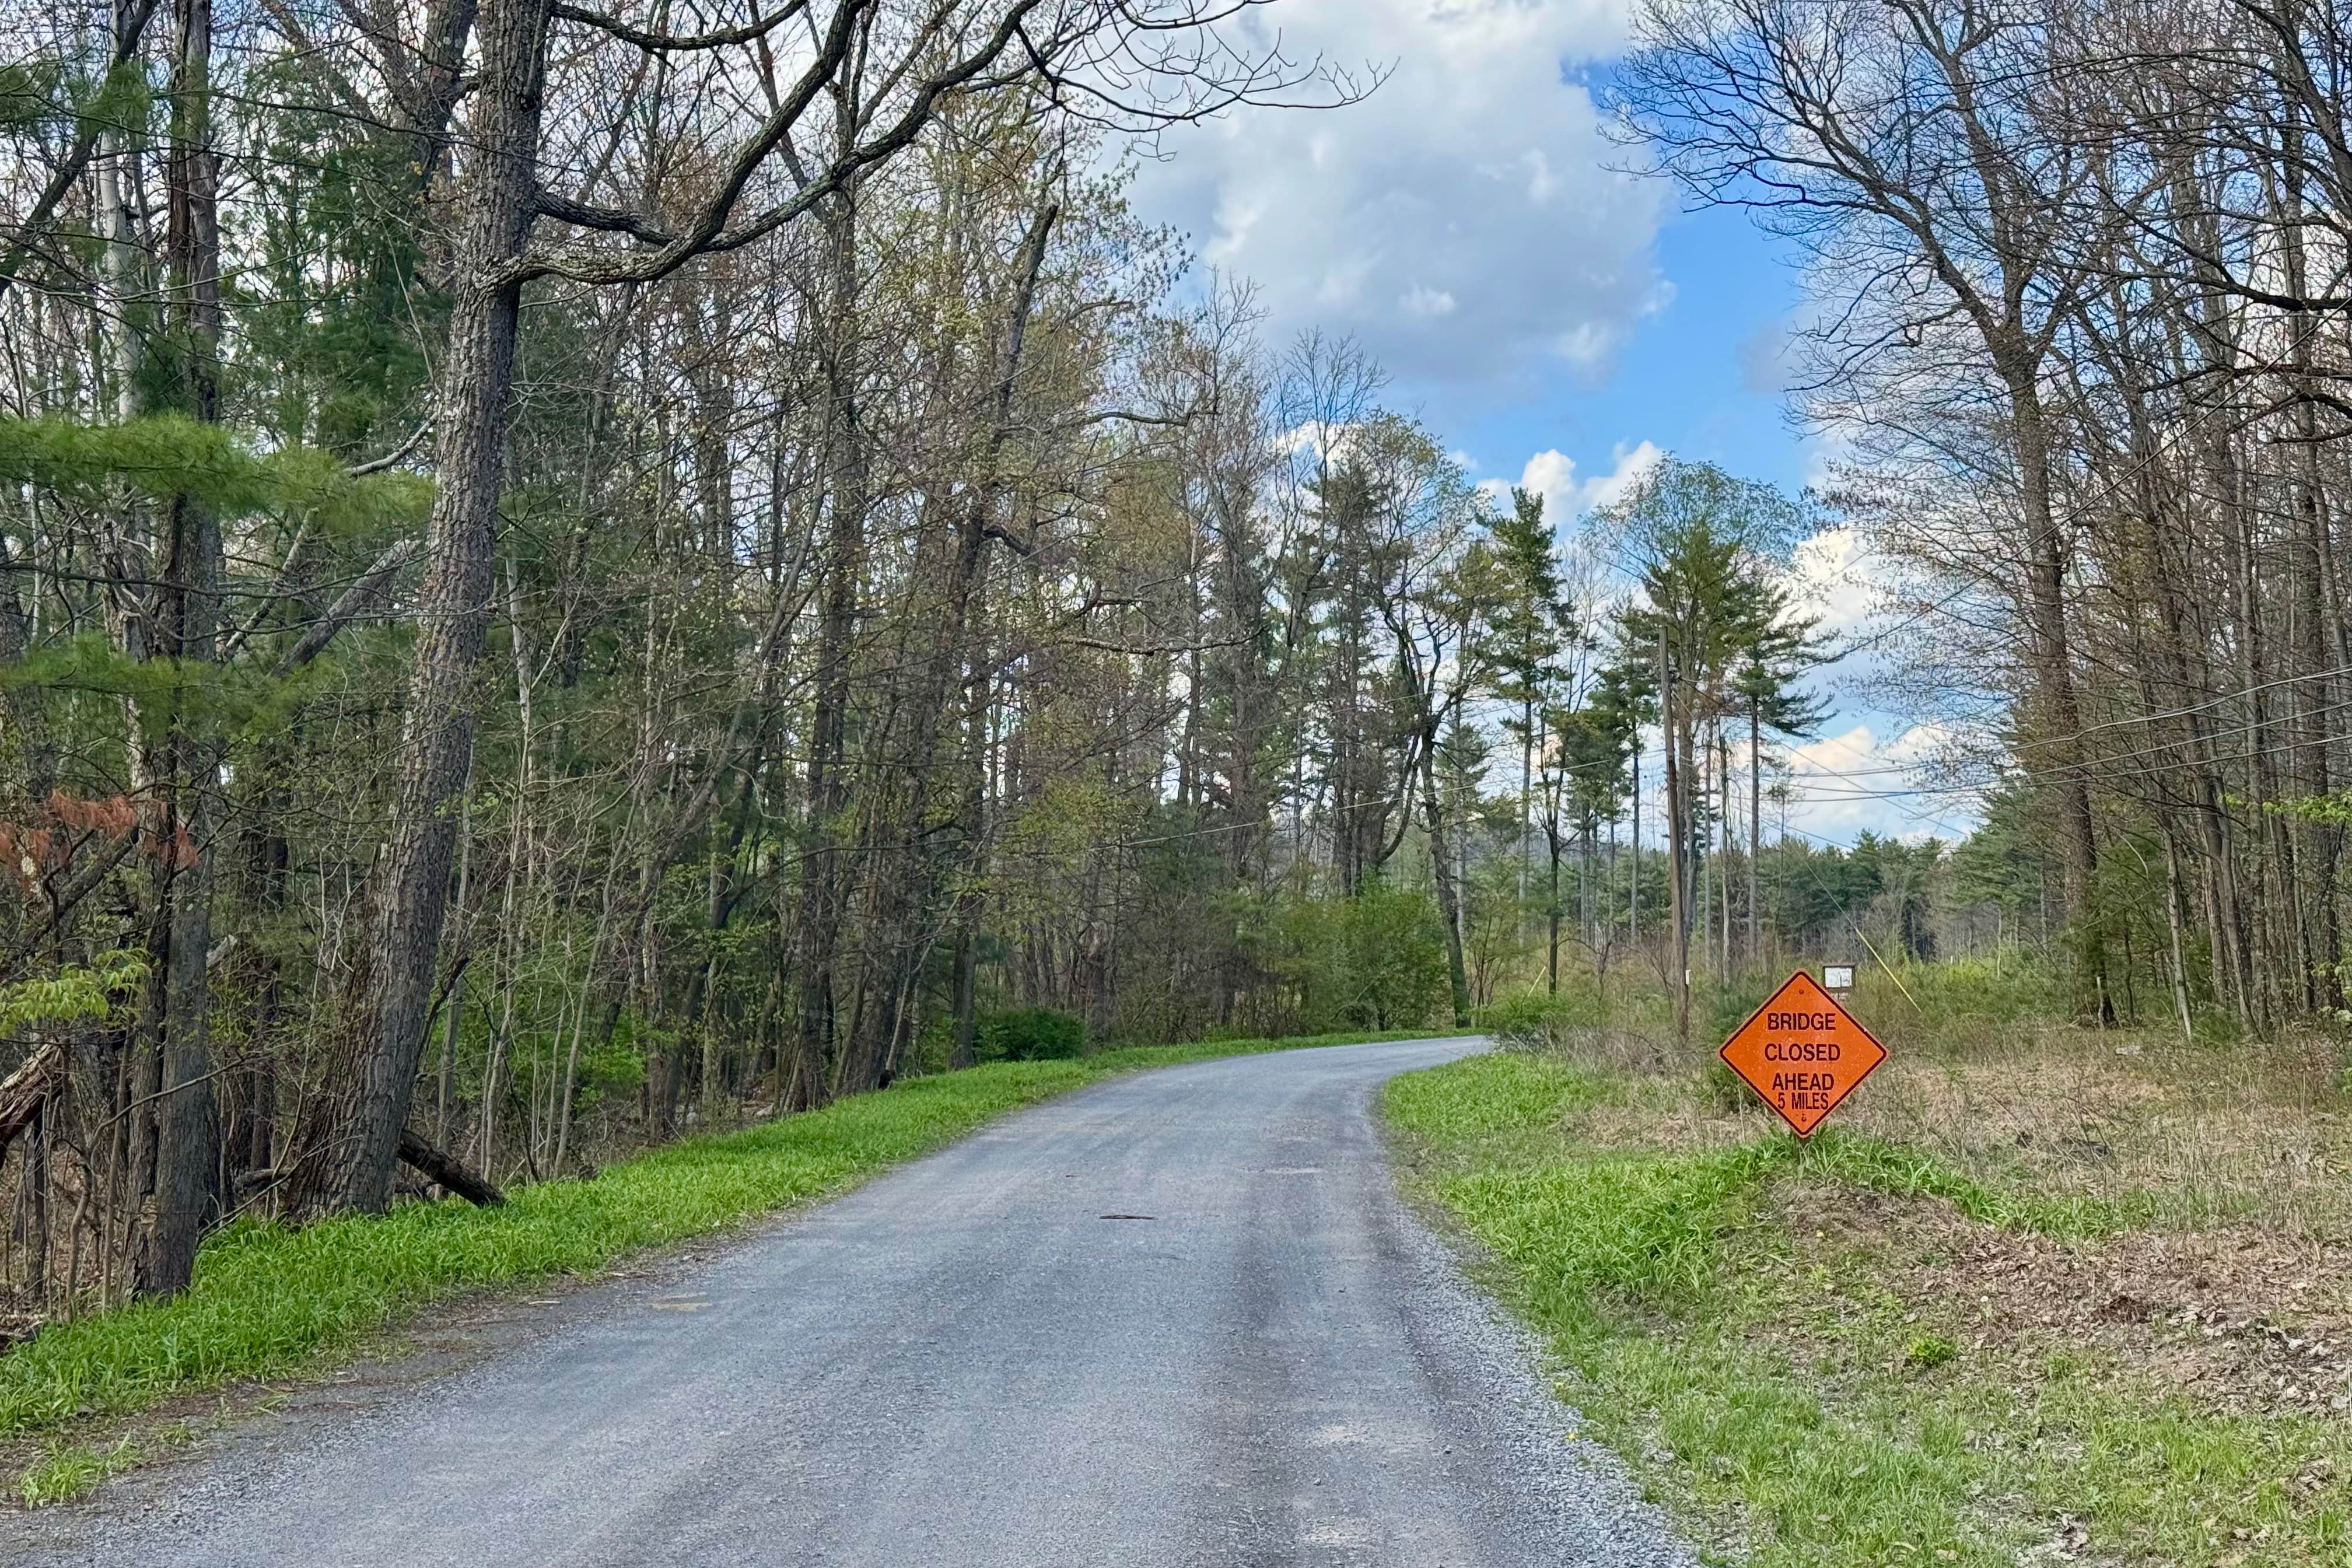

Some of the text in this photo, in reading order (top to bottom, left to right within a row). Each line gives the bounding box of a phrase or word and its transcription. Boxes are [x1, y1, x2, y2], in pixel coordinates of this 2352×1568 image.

[1768, 1013, 1836, 1031] BRIDGE
[1765, 1043, 1840, 1062] CLOSED
[1772, 1073, 1835, 1090] AHEAD
[1777, 1092, 1829, 1110] 5 MILES
